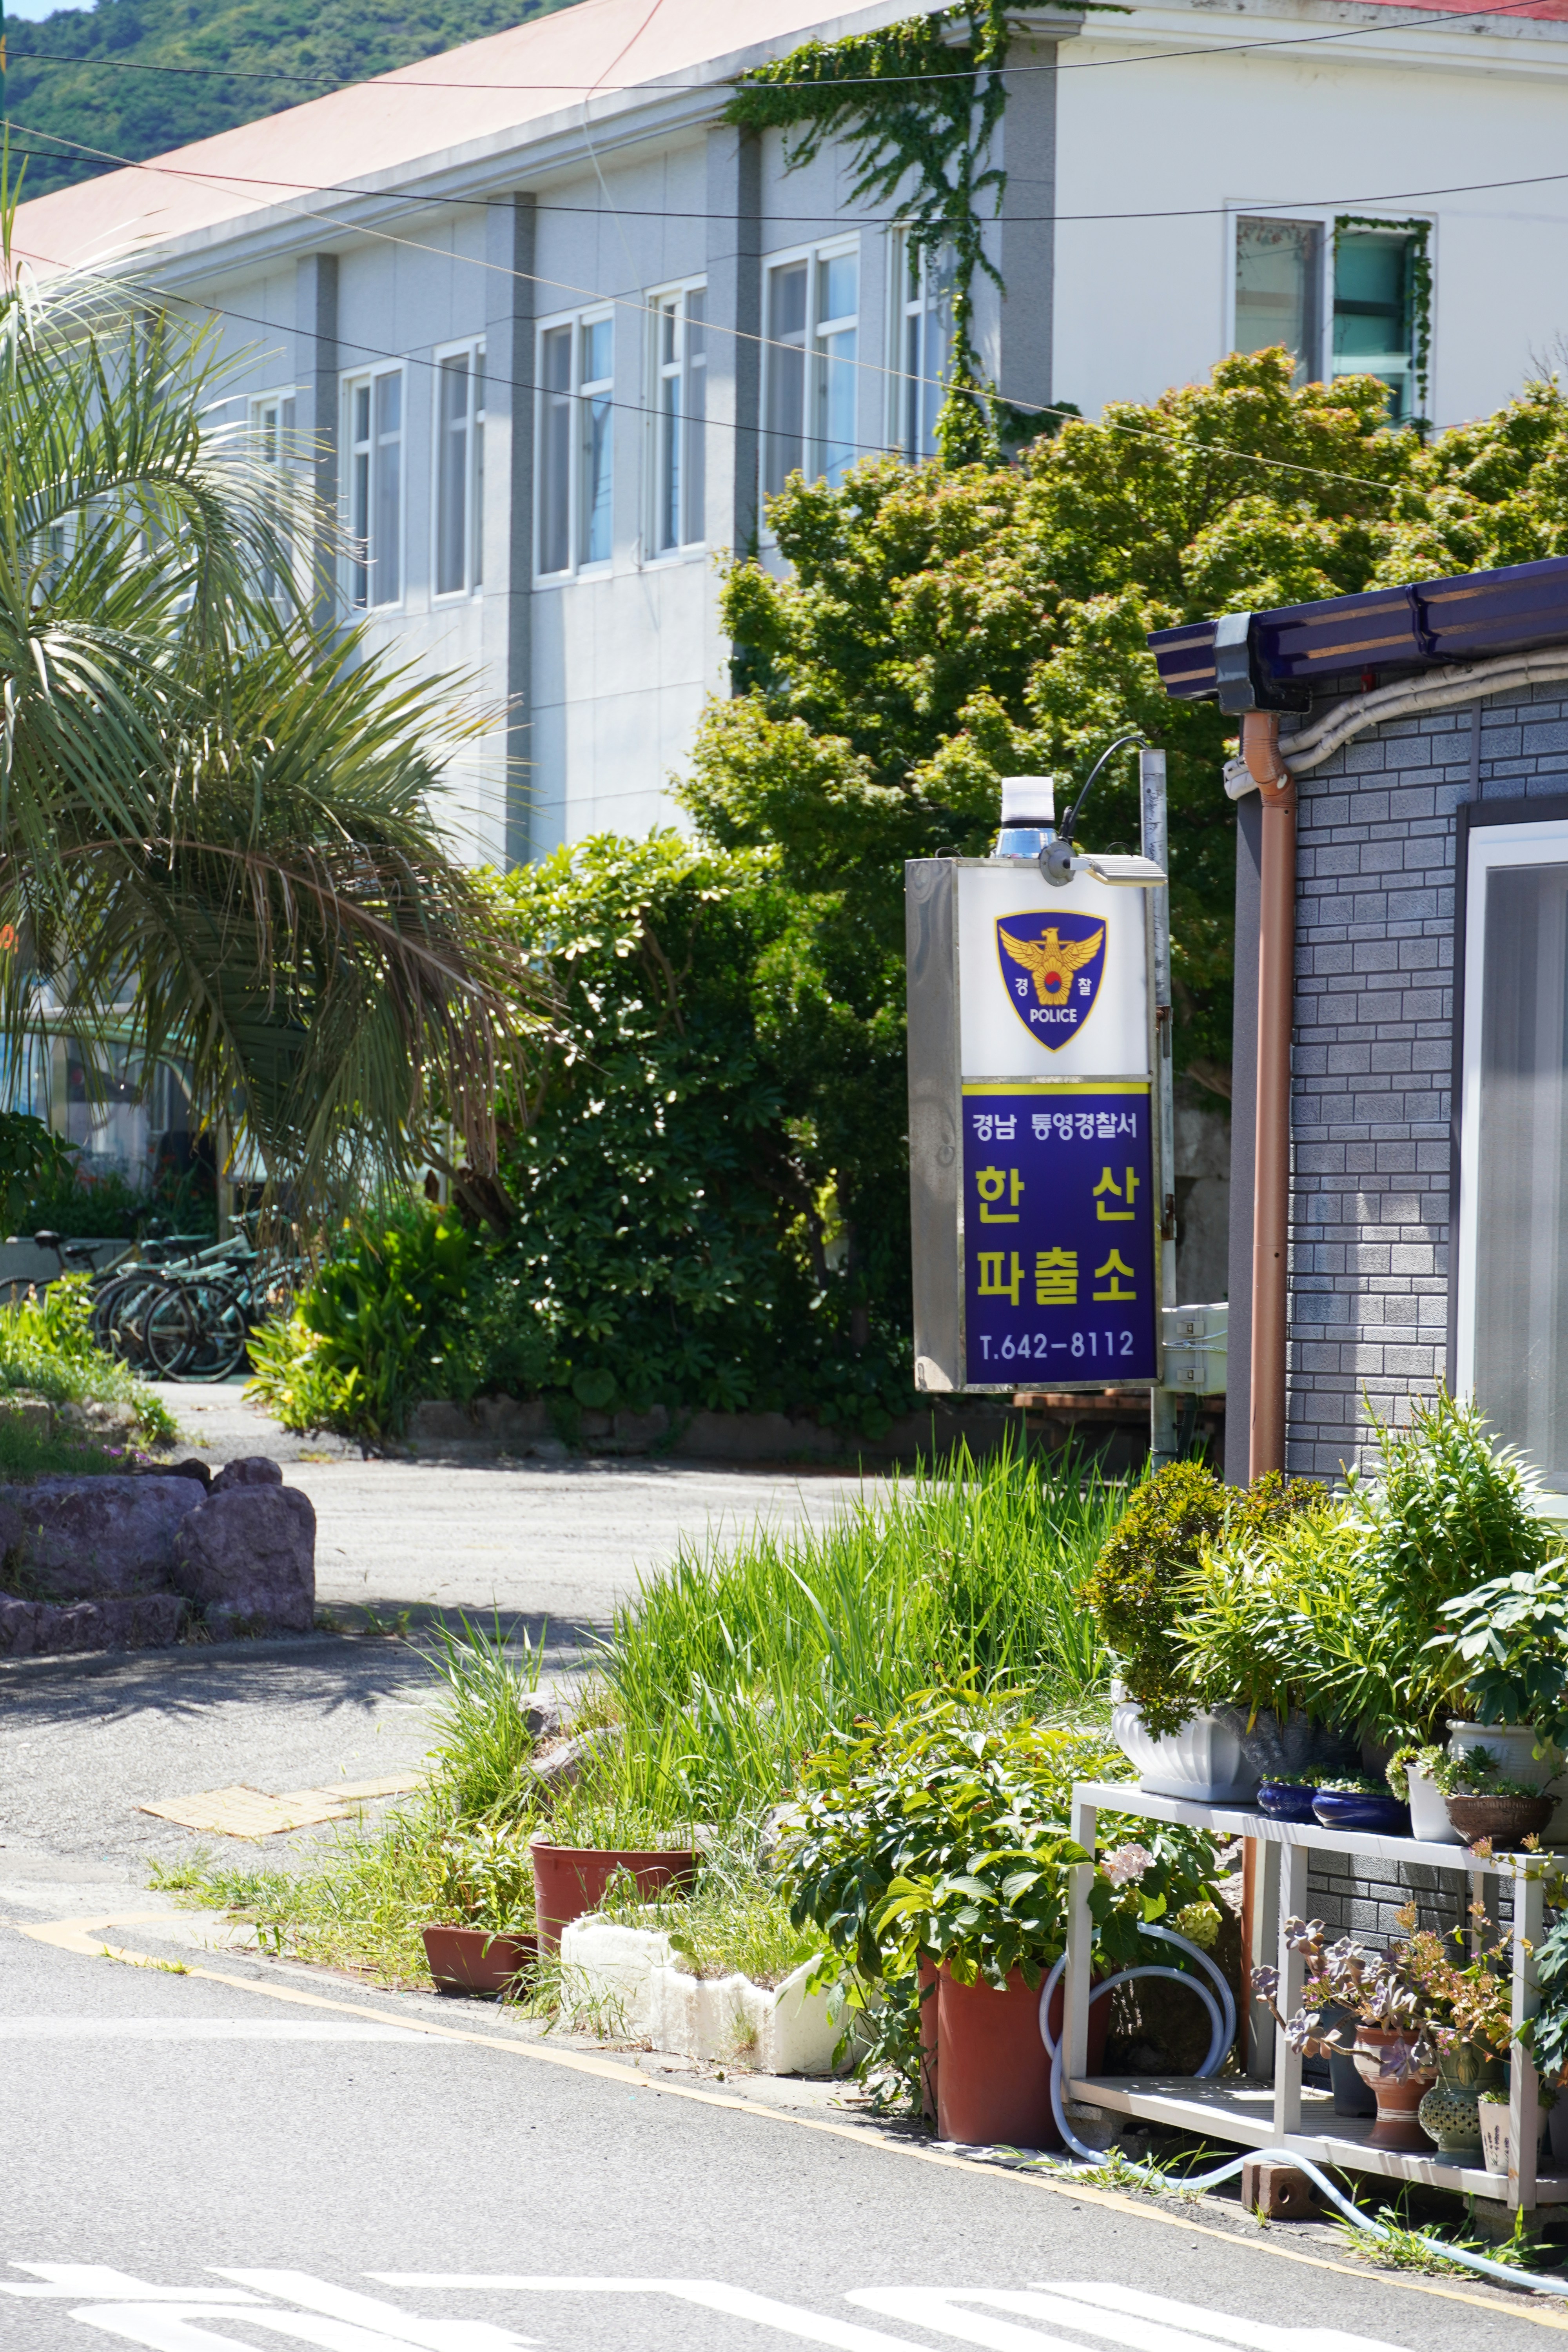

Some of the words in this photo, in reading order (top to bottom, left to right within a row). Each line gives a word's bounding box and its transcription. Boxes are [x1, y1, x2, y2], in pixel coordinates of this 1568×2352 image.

[1014, 978, 1029, 997] 경
[1078, 977, 1092, 996] 찰
[1029, 1008, 1078, 1023] POLICE
[973, 1114, 1018, 1142] 경남
[1031, 1111, 1137, 1141] 통영경찰서
[980, 1330, 1134, 1361] T.642-8112
